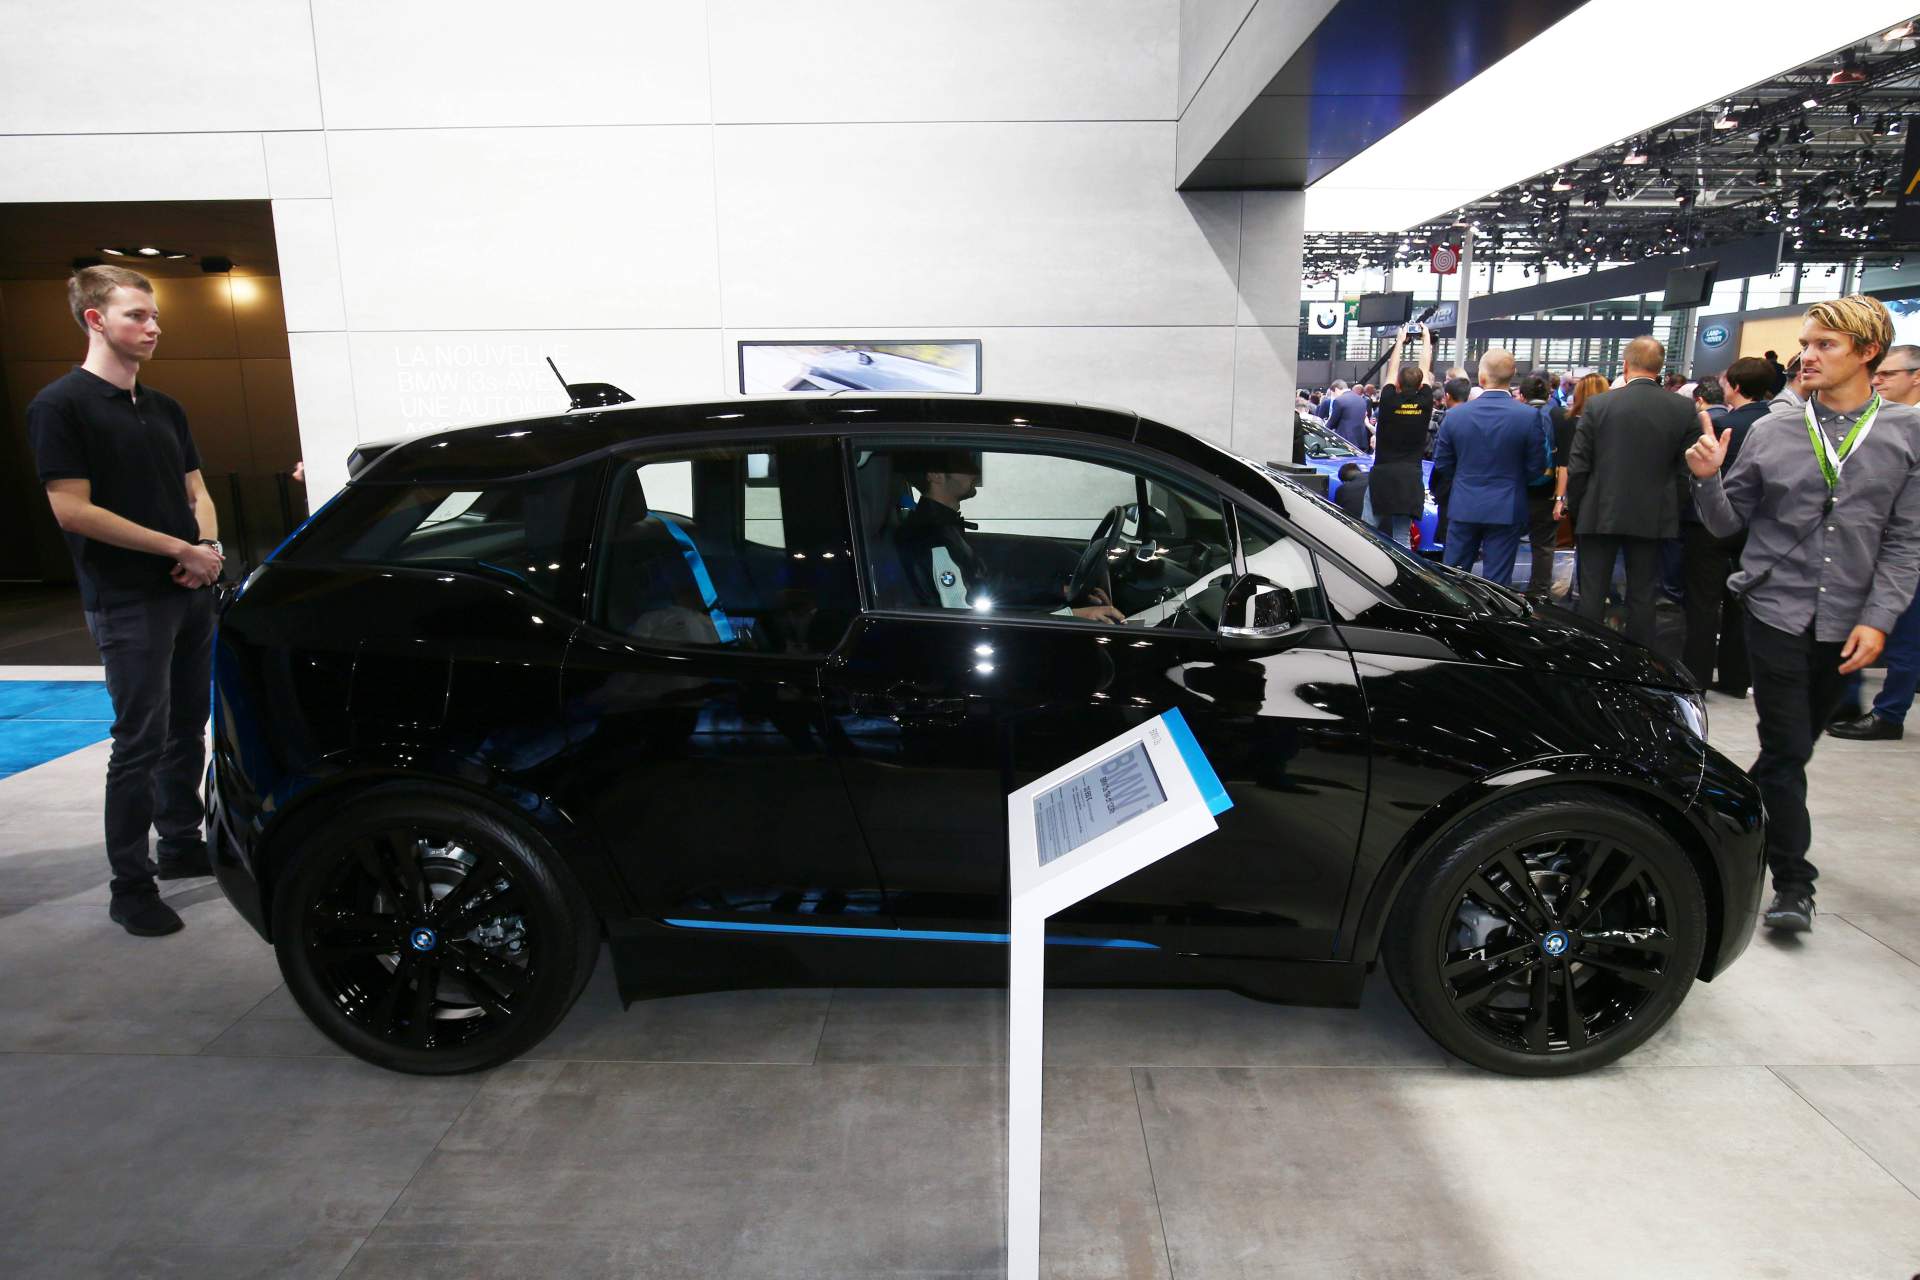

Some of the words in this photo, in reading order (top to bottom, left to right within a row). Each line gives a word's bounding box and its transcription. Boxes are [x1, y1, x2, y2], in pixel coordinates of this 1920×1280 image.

[394, 345, 425, 367] LA
[435, 344, 569, 367] NOUVELLE
[398, 371, 458, 393] BMW
[400, 395, 449, 417] UNE
[1101, 750, 1150, 810] BMW
